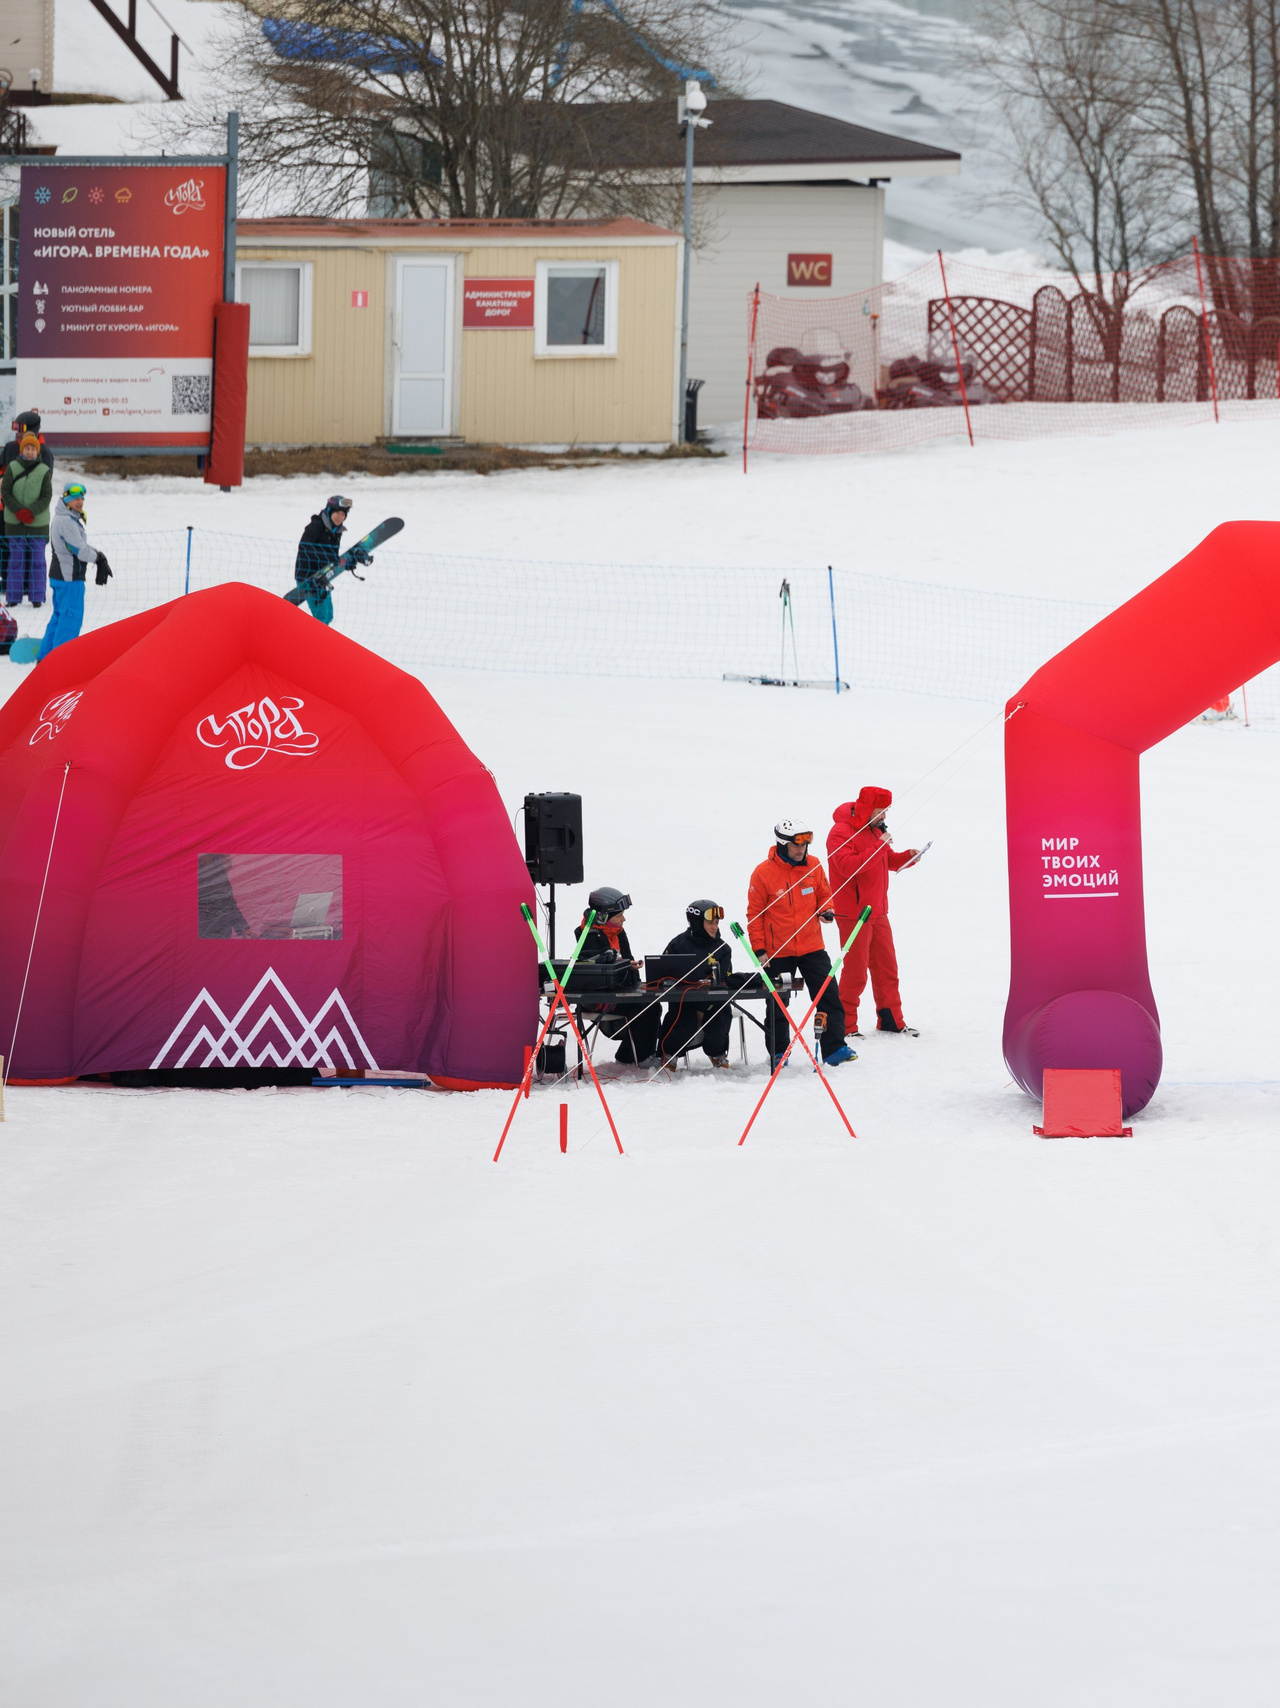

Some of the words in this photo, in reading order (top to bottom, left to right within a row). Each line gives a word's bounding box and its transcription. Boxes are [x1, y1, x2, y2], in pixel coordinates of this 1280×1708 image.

[34, 226, 76, 238] НОВЫЙ
[78, 227, 115, 238] ОТЕЛЬ
[33, 245, 93, 259] «ИГОРА.
[95, 245, 161, 259] ВРЕМЕНА
[164, 245, 210, 260] ГОДА»
[791, 261, 828, 280] WC
[61, 286, 118, 294] ПАНОРАМНЫЕ
[119, 286, 153, 294] НОМЕРА
[465, 290, 532, 299] АДМИНИСТРАТОР
[61, 303, 98, 312] УЮТНЫЙ
[98, 304, 144, 312] ЛОББИ-БАР
[485, 308, 511, 317] ДОРОГ
[66, 324, 95, 332] МИНУТ
[95, 324, 107, 332] ОТ
[108, 324, 144, 332] КУРОРТА
[1041, 837, 1079, 850] МИР
[1041, 855, 1100, 869] ТВОИХ
[1042, 869, 1118, 888] ЭМОЦИЙ
